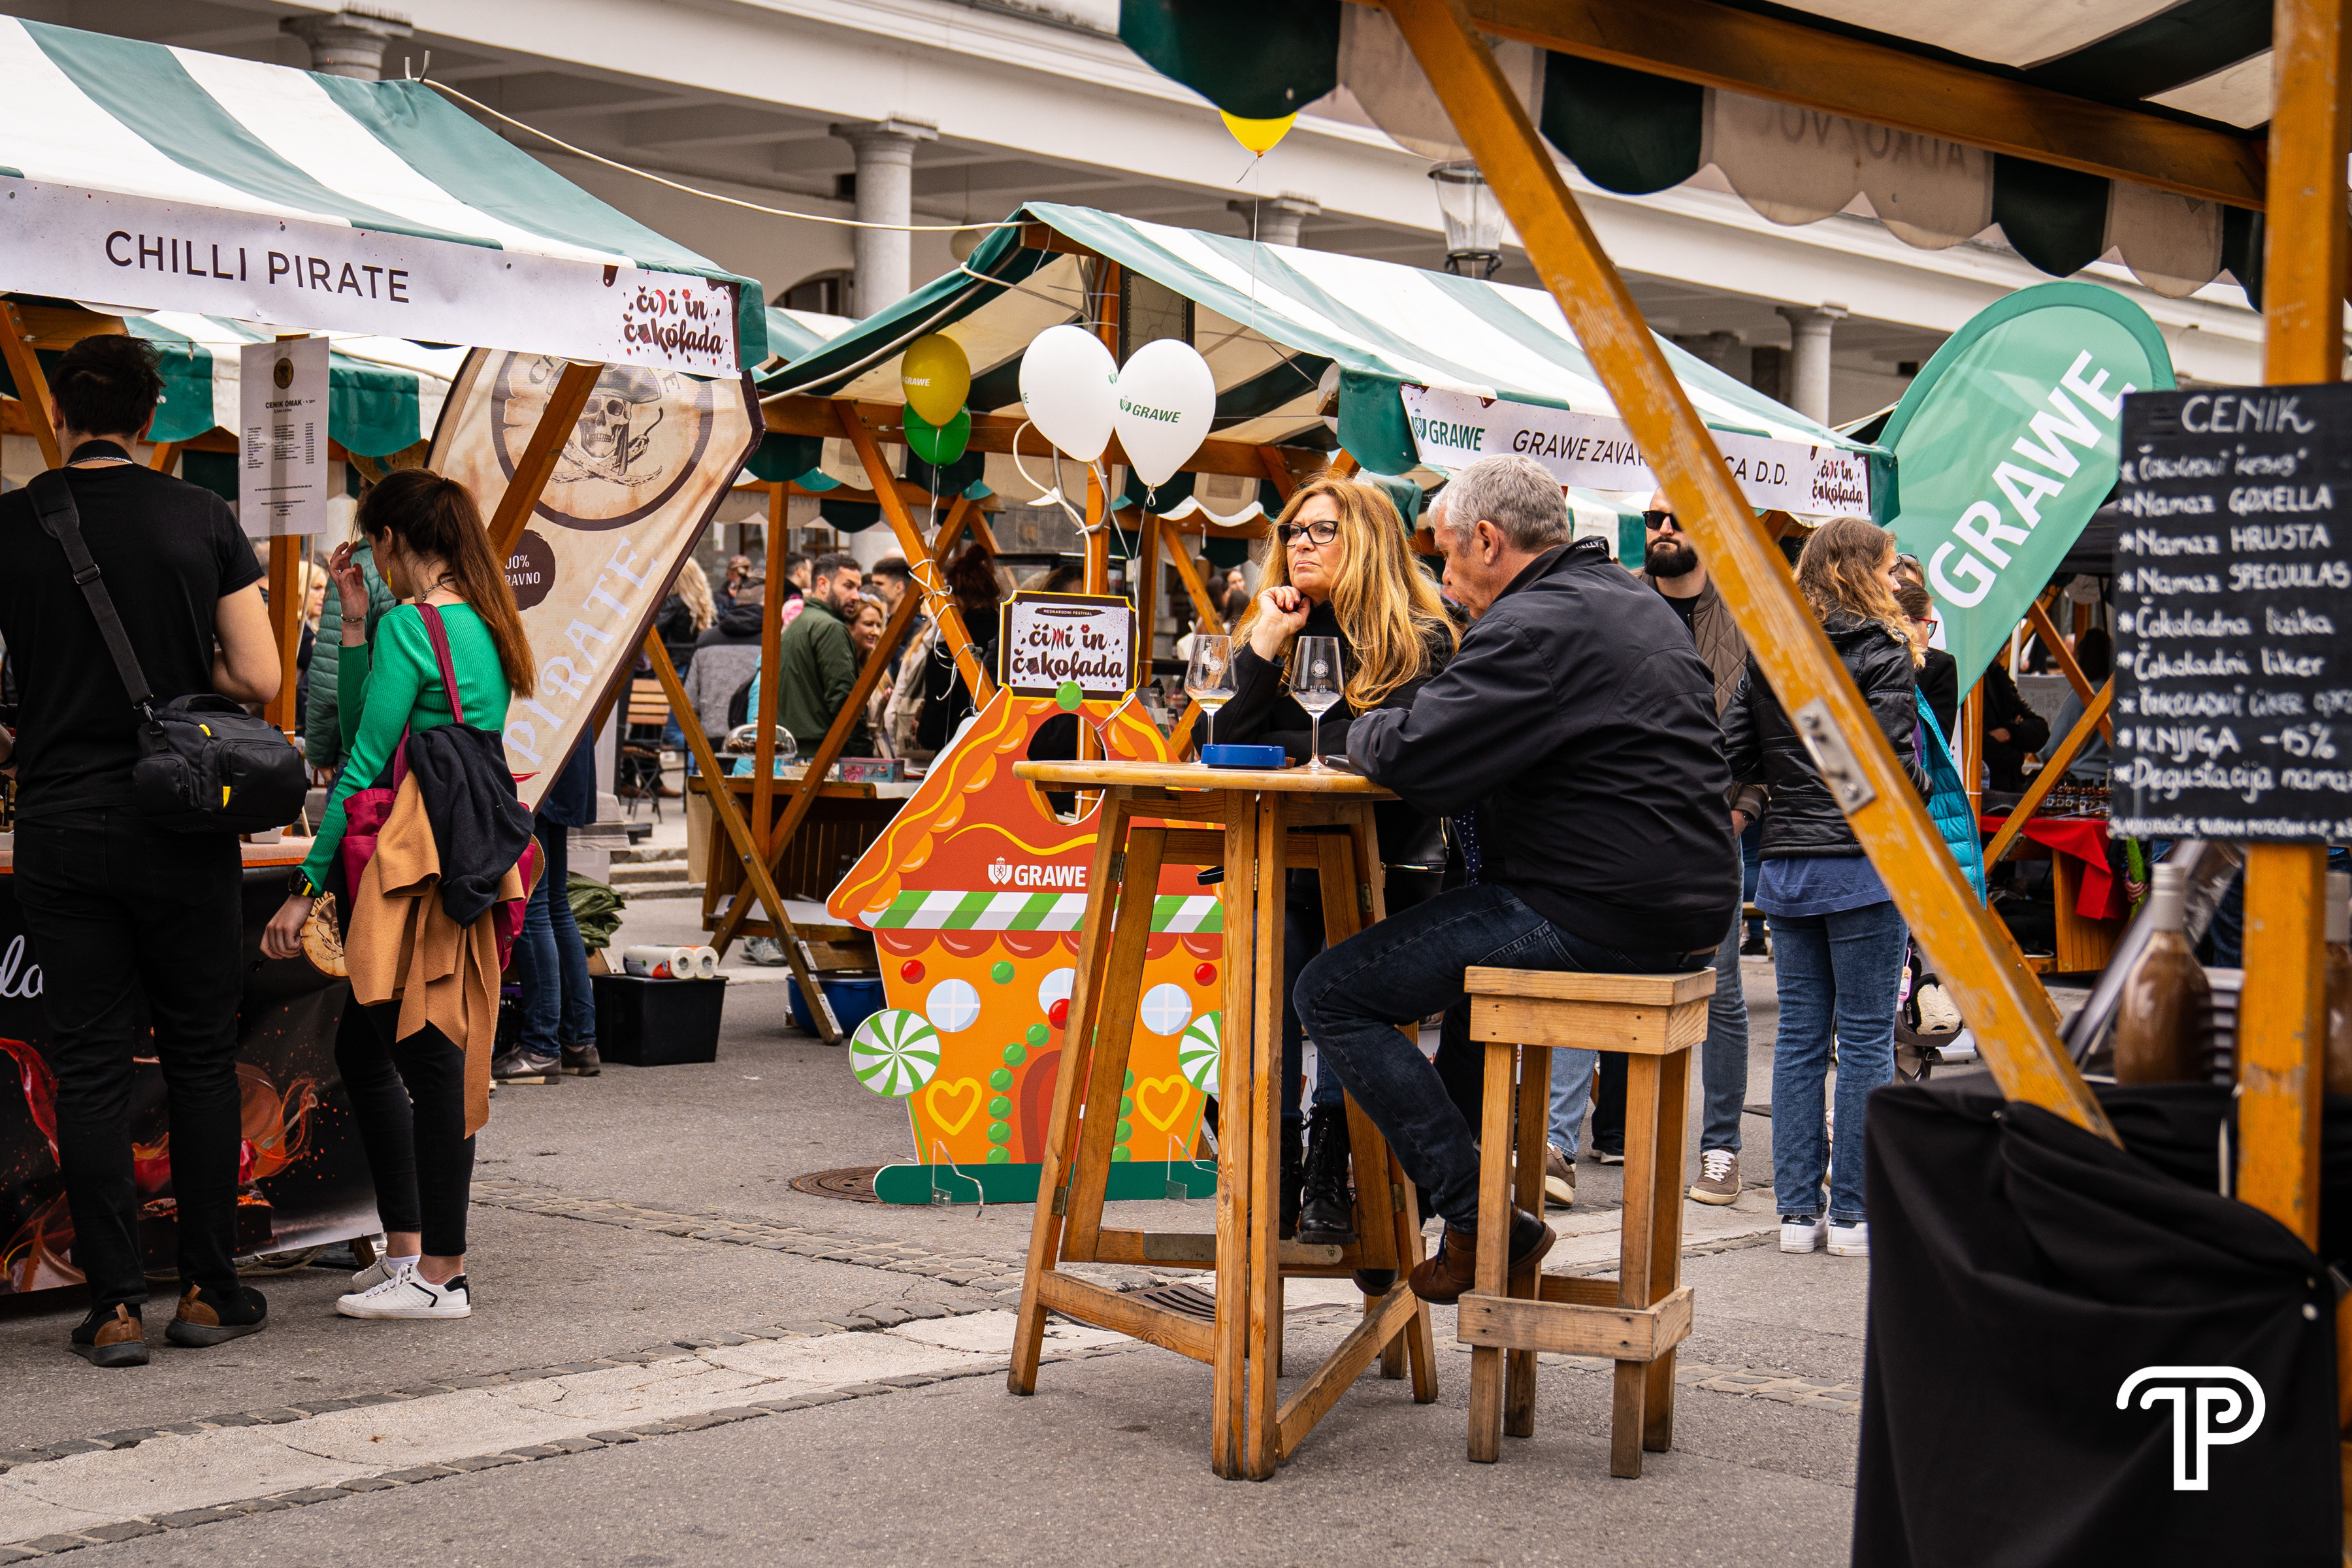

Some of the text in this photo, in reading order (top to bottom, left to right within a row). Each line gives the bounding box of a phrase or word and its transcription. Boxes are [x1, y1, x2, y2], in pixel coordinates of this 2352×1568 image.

[106, 231, 410, 303] CHILLI PIRATE
[681, 289, 708, 319] in
[904, 376, 931, 387] GRAWE
[1132, 404, 1181, 423] GRAWE
[2181, 395, 2315, 433] CENIK
[1429, 419, 1486, 451] GRAWE
[1512, 429, 1590, 461] GRAWE
[1756, 461, 1788, 486] D.D.
[1929, 350, 2137, 608] GRAWE
[2133, 491, 2215, 517] Namaz
[2136, 523, 2330, 555] Namaz HRUSTA
[505, 572, 540, 586] RAVNO
[2136, 566, 2221, 594] Namaz
[2135, 595, 2253, 638] Čokoladna
[502, 537, 657, 766] PIRATE
[1081, 624, 1107, 650] in
[2134, 640, 2326, 681] Čokoladni liker
[2135, 722, 2242, 763] KNJIGA
[2131, 757, 2276, 804] Degustacija
[1014, 864, 1086, 887] GRAWE
